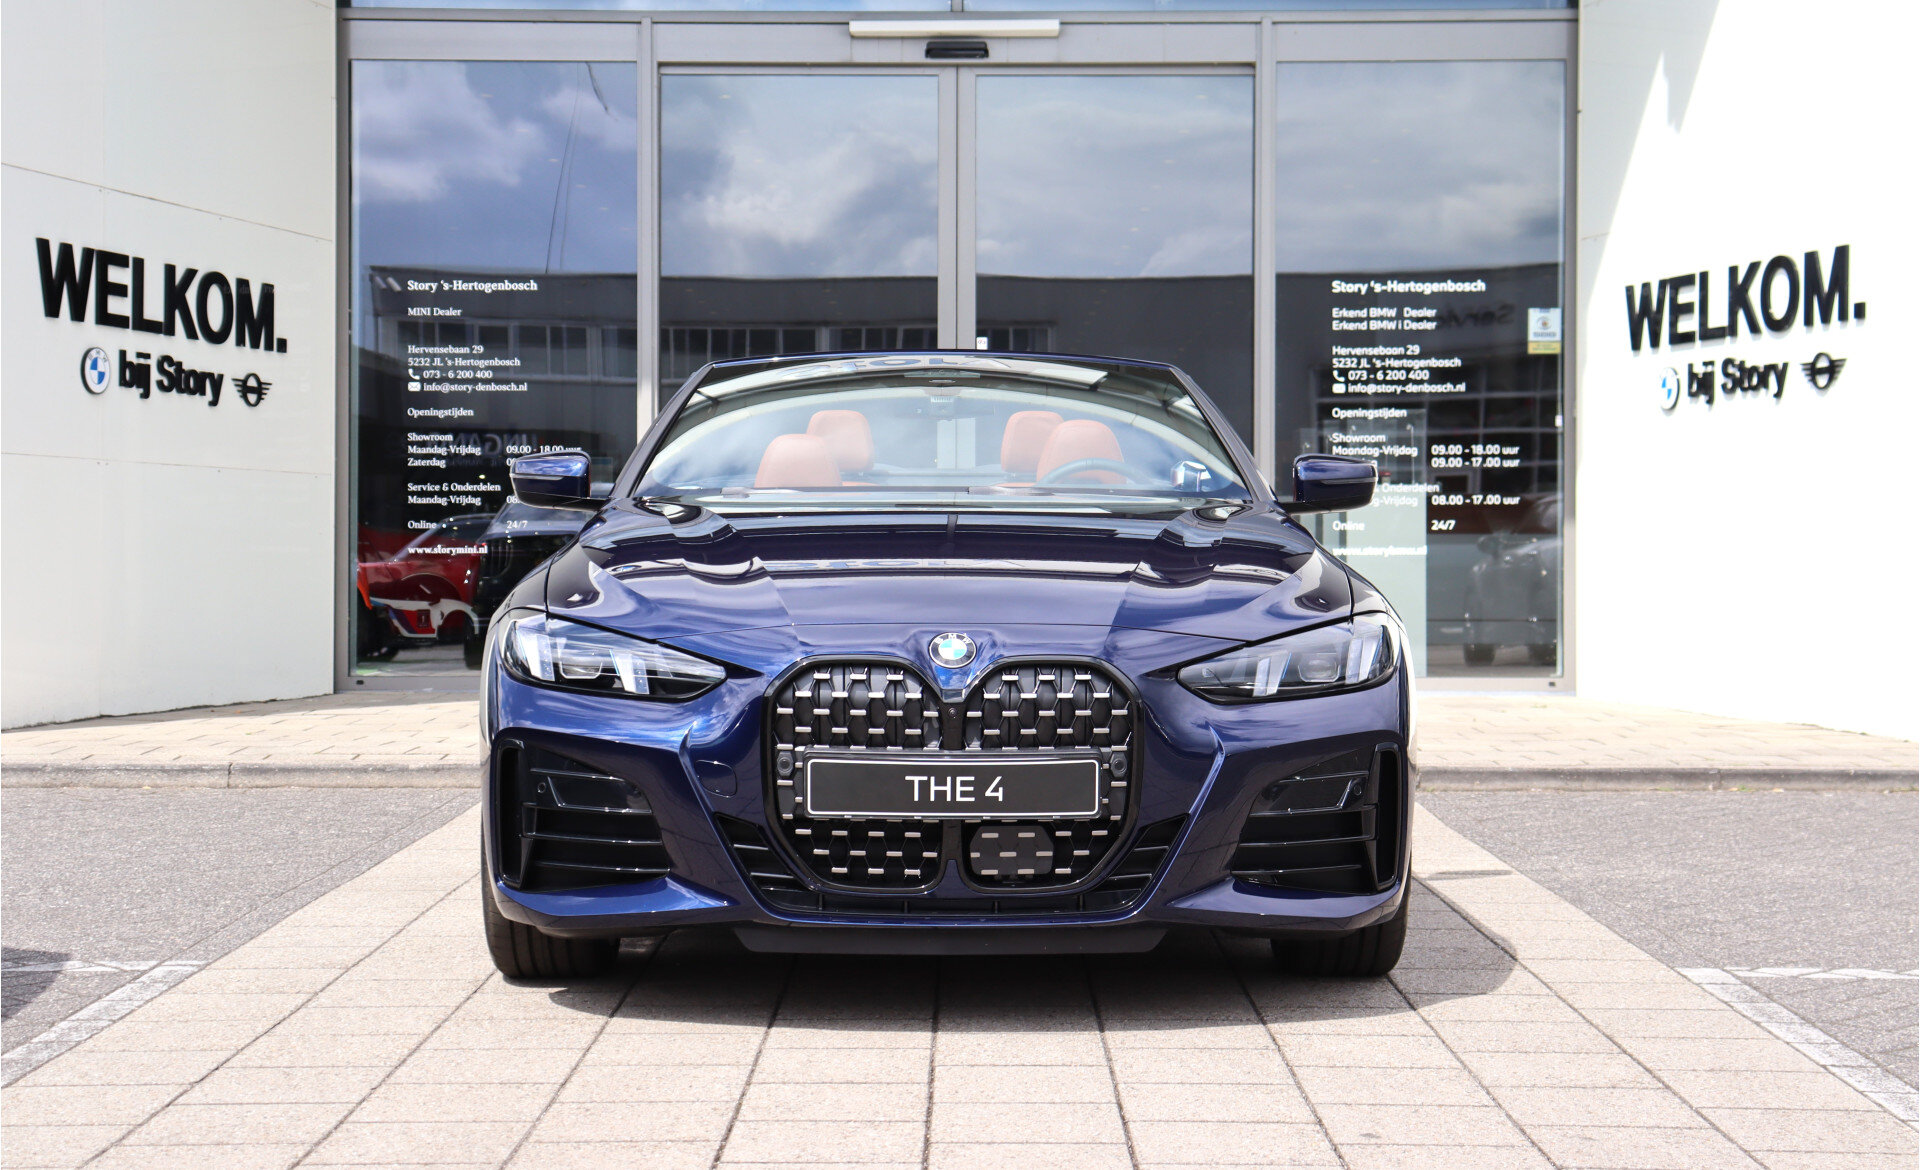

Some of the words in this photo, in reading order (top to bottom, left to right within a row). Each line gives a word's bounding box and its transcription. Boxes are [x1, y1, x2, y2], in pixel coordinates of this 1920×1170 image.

[408, 280, 438, 293] Story
[441, 280, 537, 293] 's-Hertogenbosch
[1332, 281, 1368, 295] Story
[1370, 280, 1485, 295] 's-Hertogenbosch
[36, 237, 288, 354] WELKOM.
[1625, 244, 1866, 351] WELKOM.
[408, 307, 431, 316] MINI
[433, 307, 462, 316] Dealer
[1332, 308, 1367, 318] Erkend
[1369, 308, 1397, 317] BMW
[1403, 307, 1436, 317] Dealer
[1332, 320, 1367, 330] Erkend
[1369, 320, 1396, 330] BMW
[1404, 320, 1436, 330] Dealer
[408, 345, 470, 354] Hervensebaan
[472, 345, 484, 354] 29
[1332, 346, 1404, 355] Hervensebaan
[1406, 345, 1420, 355] 29
[408, 357, 430, 366] 5232
[432, 358, 444, 366] JL
[445, 357, 521, 368] 's-Hertogenbosch
[1333, 358, 1357, 368] 5232
[1359, 358, 1370, 368] JL
[1373, 358, 1461, 369] 's-Hertogenbosch
[118, 349, 151, 400] bij
[156, 354, 224, 407] Story
[423, 370, 441, 378] 073
[448, 370, 454, 378] 6
[456, 370, 474, 378] 200
[475, 370, 493, 378] 400
[1348, 370, 1367, 380] 073
[1377, 371, 1383, 380] 6
[1386, 370, 1406, 380] 200
[1408, 370, 1429, 380] 400
[1687, 360, 1715, 405] bij
[1721, 357, 1789, 399] Story
[424, 382, 527, 393] info@story-denbosch.nl
[1348, 383, 1465, 395] info@story-denbosch.nl
[407, 407, 474, 418] Openingstijden
[1332, 408, 1407, 420] Openingstijden
[408, 433, 453, 441] Showroom
[1332, 433, 1386, 442] Showroom
[408, 445, 481, 455] Maandag-Vrijdag
[506, 445, 531, 453] 09.00
[1333, 446, 1418, 457] Maandag-Vrijdag
[1431, 445, 1462, 455] 09.00
[1471, 444, 1500, 455] 18.00
[408, 458, 446, 468] Zaterdag
[1431, 457, 1462, 467] 09.00
[408, 483, 440, 491] Service
[451, 483, 501, 491] Onderdelen
[1382, 483, 1439, 493] Onderdelen
[408, 495, 481, 506] Maandag-Vrijdag
[1432, 495, 1463, 505] 08.00
[1503, 497, 1520, 505] uur
[407, 520, 437, 529] Online
[506, 520, 528, 529] 24/7
[1332, 521, 1365, 531] Online
[1431, 520, 1455, 530] 24/7
[407, 545, 488, 555] www.storymini.nl
[905, 776, 976, 802] THE
[984, 776, 1004, 802] 4
